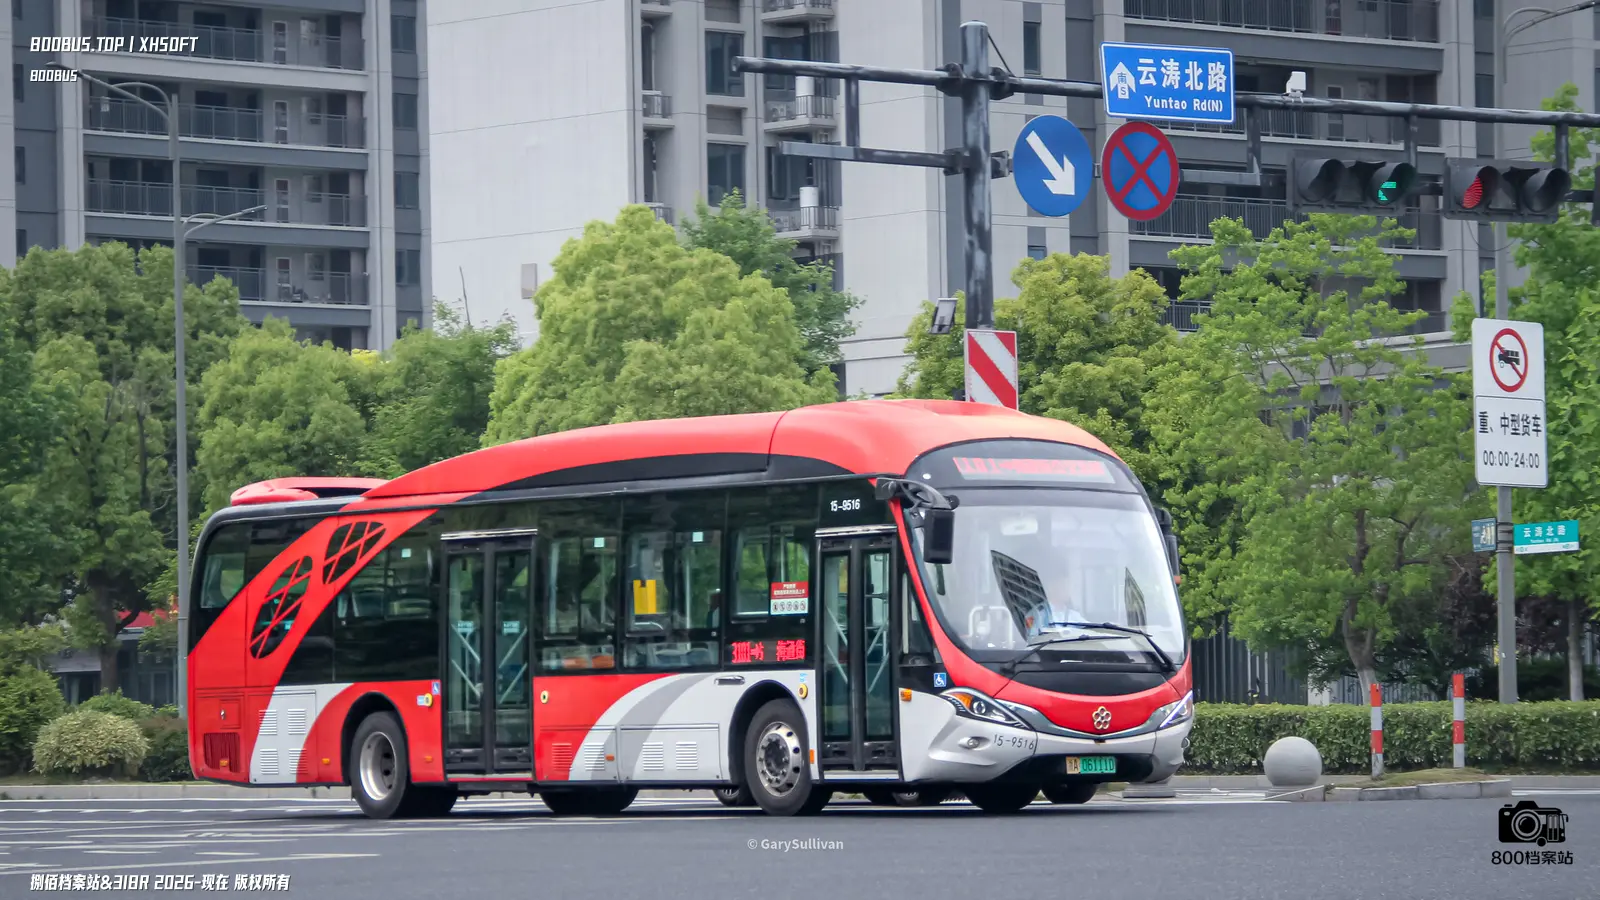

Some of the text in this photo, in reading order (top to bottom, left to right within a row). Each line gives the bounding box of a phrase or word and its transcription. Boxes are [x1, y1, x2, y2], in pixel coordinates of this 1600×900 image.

[1137, 58, 1227, 93] 云涛北路
[1119, 86, 1127, 96] S
[1144, 95, 1224, 112] Yuntao Rd(N)
[1478, 410, 1542, 437] 重、中型货车
[830, 498, 861, 512] 15-9516
[993, 733, 1034, 751] 15-9516
